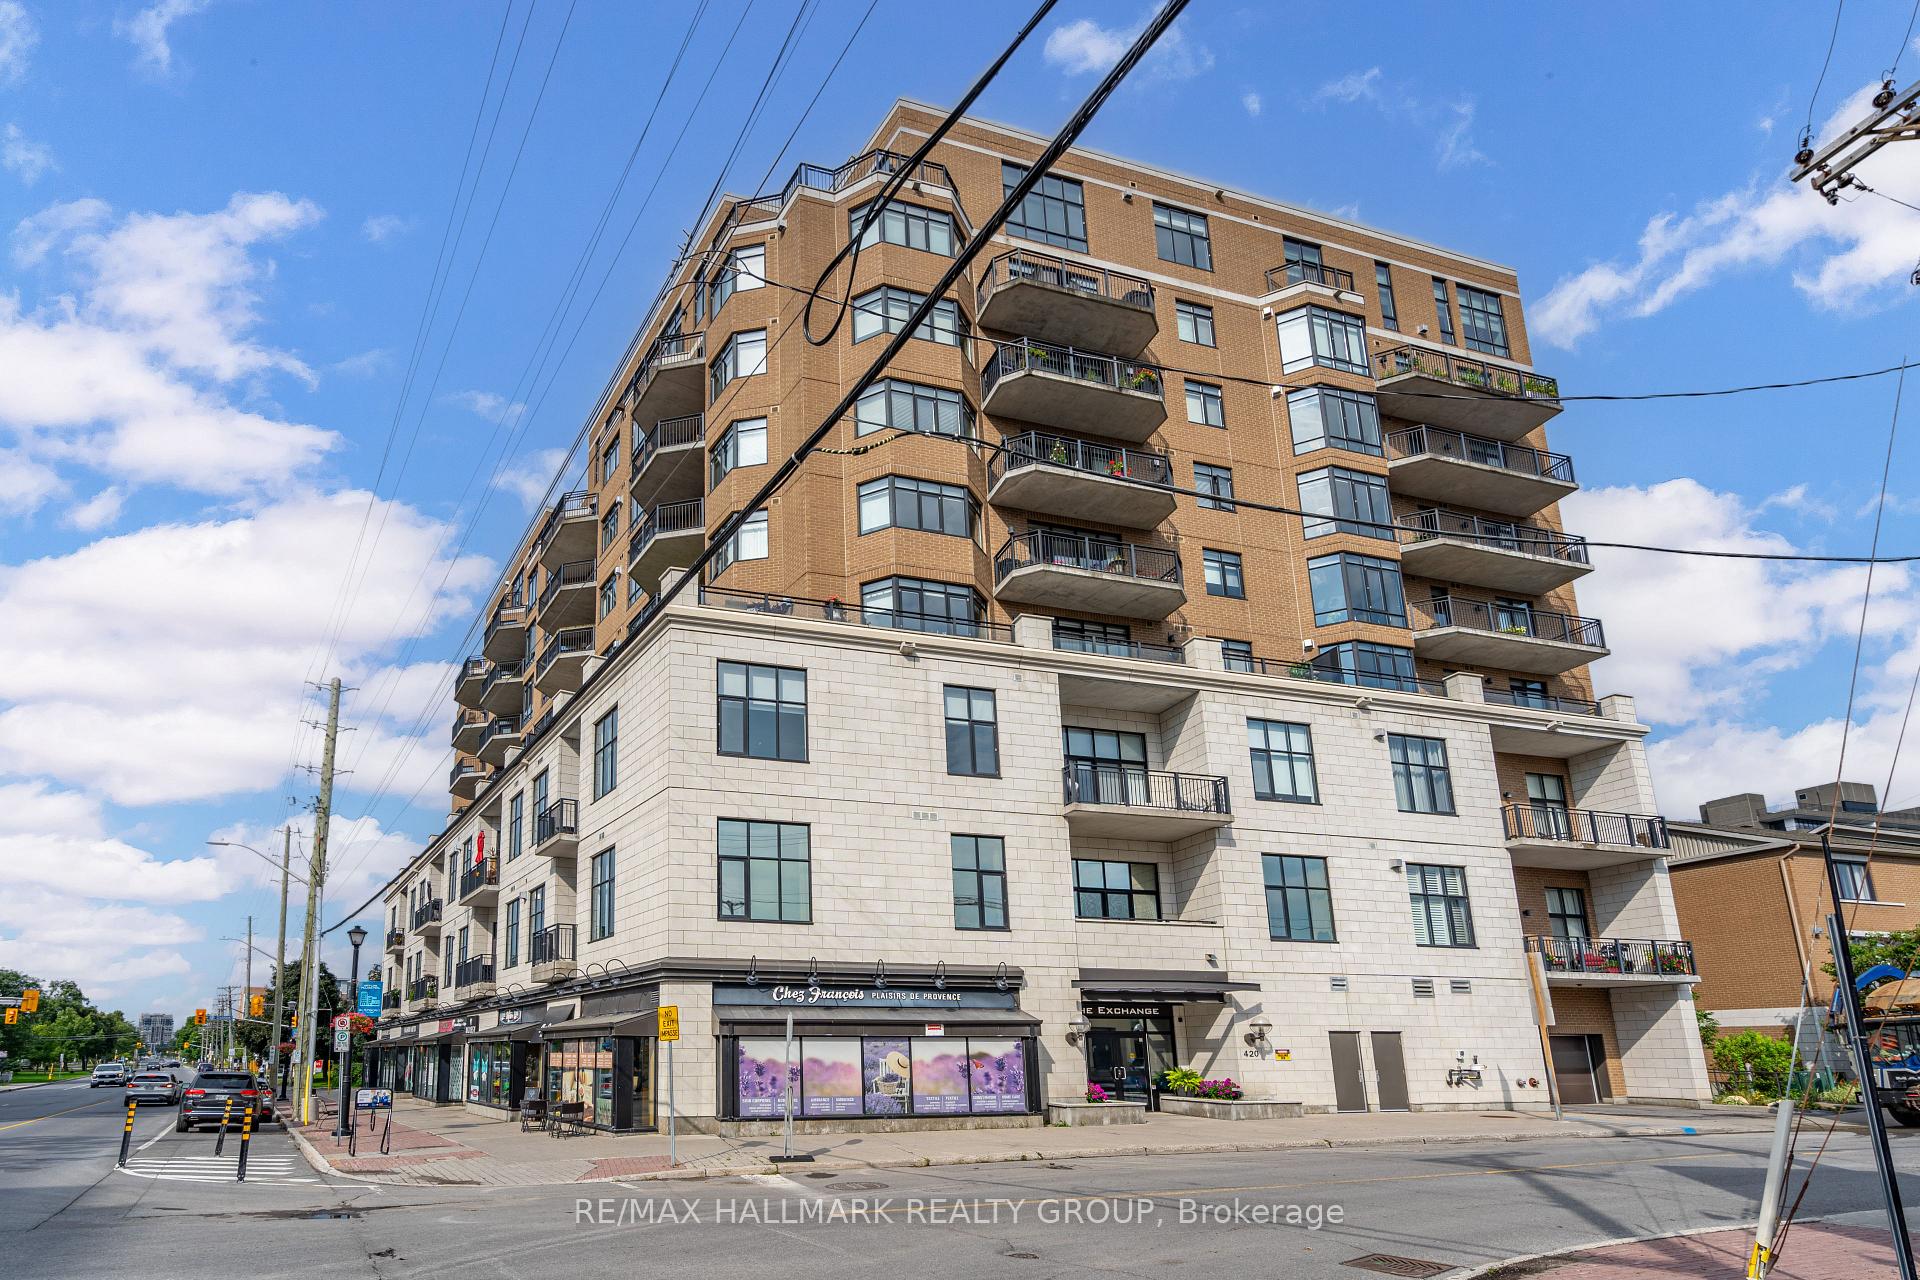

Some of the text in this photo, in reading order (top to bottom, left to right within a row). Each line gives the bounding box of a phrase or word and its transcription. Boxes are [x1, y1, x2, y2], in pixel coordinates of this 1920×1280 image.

[772, 985, 864, 1003] Chez François
[871, 992, 906, 1000] PLAISIRS
[923, 993, 961, 1001] PROVENCE
[665, 1010, 673, 1018] NO
[1243, 1050, 1260, 1058] 420
